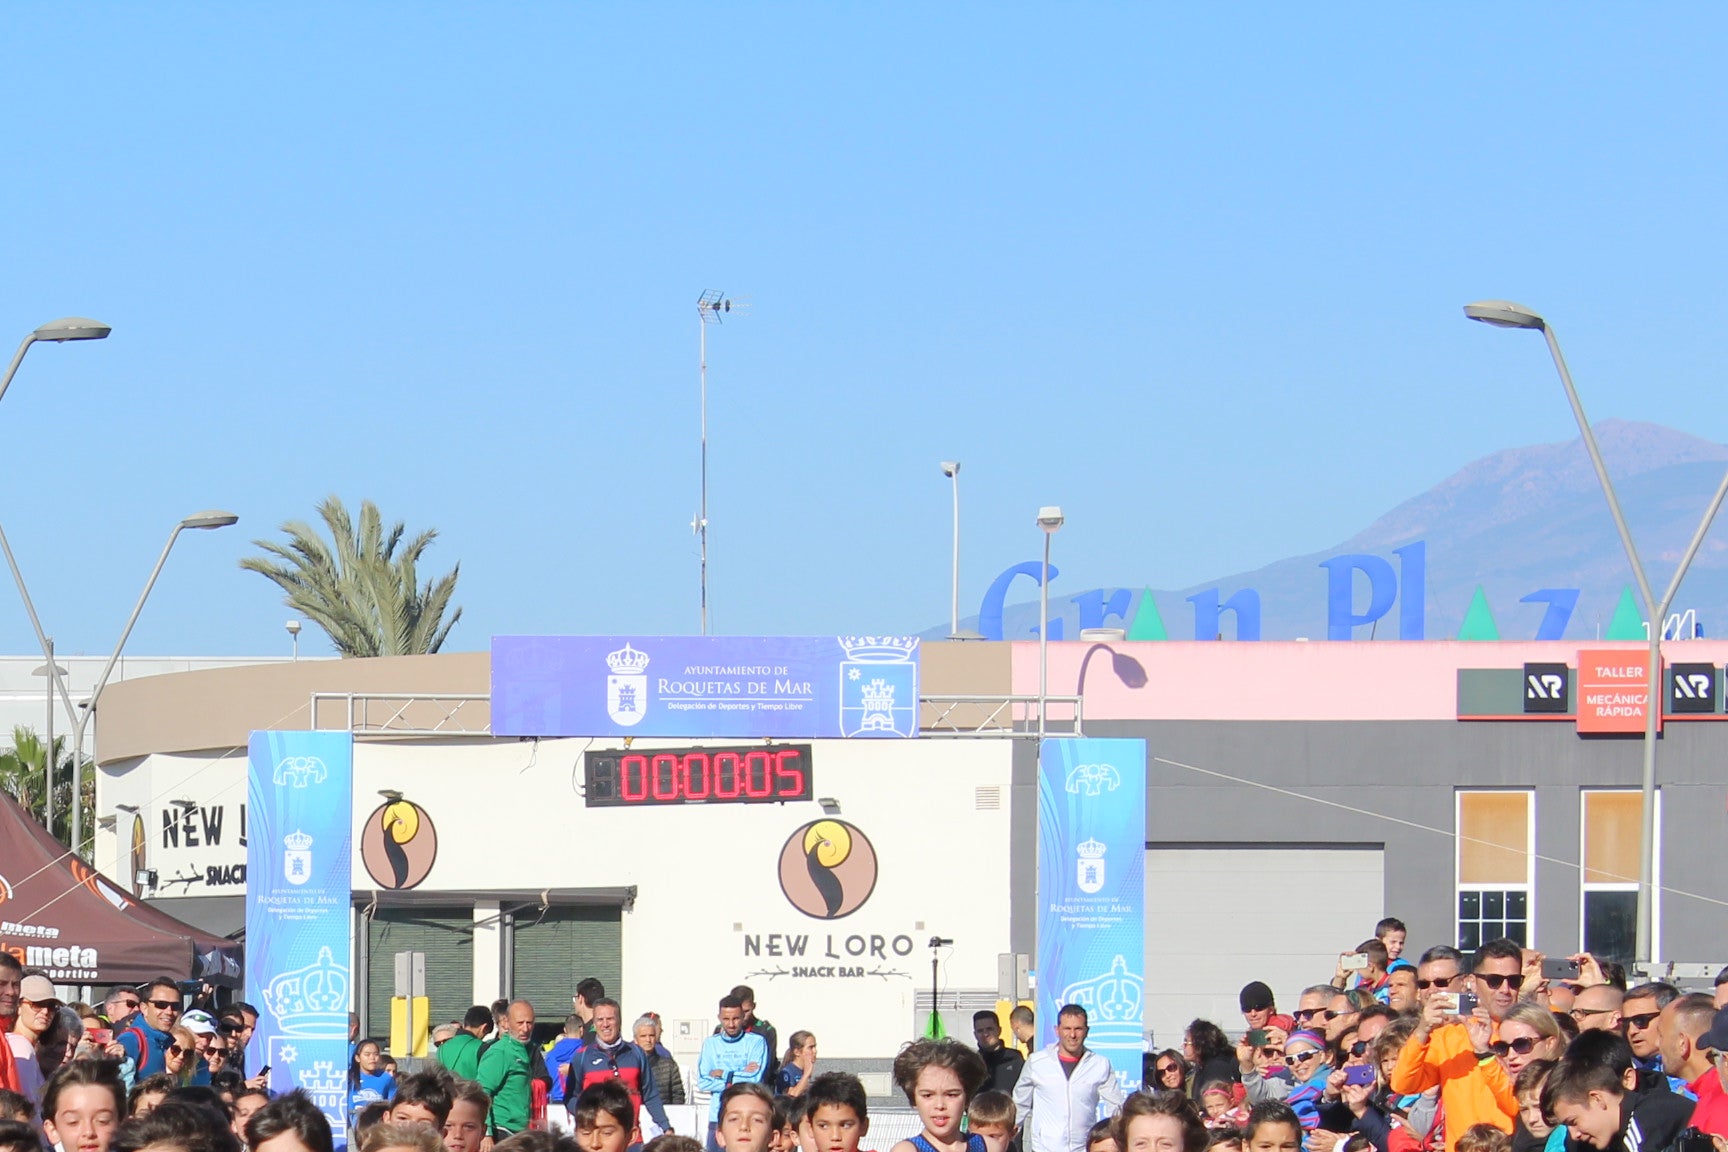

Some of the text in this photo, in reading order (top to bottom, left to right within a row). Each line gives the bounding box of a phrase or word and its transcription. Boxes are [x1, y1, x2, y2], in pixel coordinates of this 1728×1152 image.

[684, 665, 788, 676] AYUNTAMIENTO DE
[1595, 666, 1643, 678] TALLER
[658, 678, 741, 697] ROQUETAS
[747, 682, 768, 694] DE
[667, 702, 705, 711] Delegación
[707, 702, 717, 710] de
[719, 703, 750, 711] Deportes
[757, 703, 784, 712] Tiempo
[785, 703, 803, 711] Libre
[1595, 704, 1642, 717] RÁPIDA
[163, 806, 224, 849] NEW
[745, 934, 914, 960] NEW LORO
[791, 966, 865, 978] SNACK BAR
